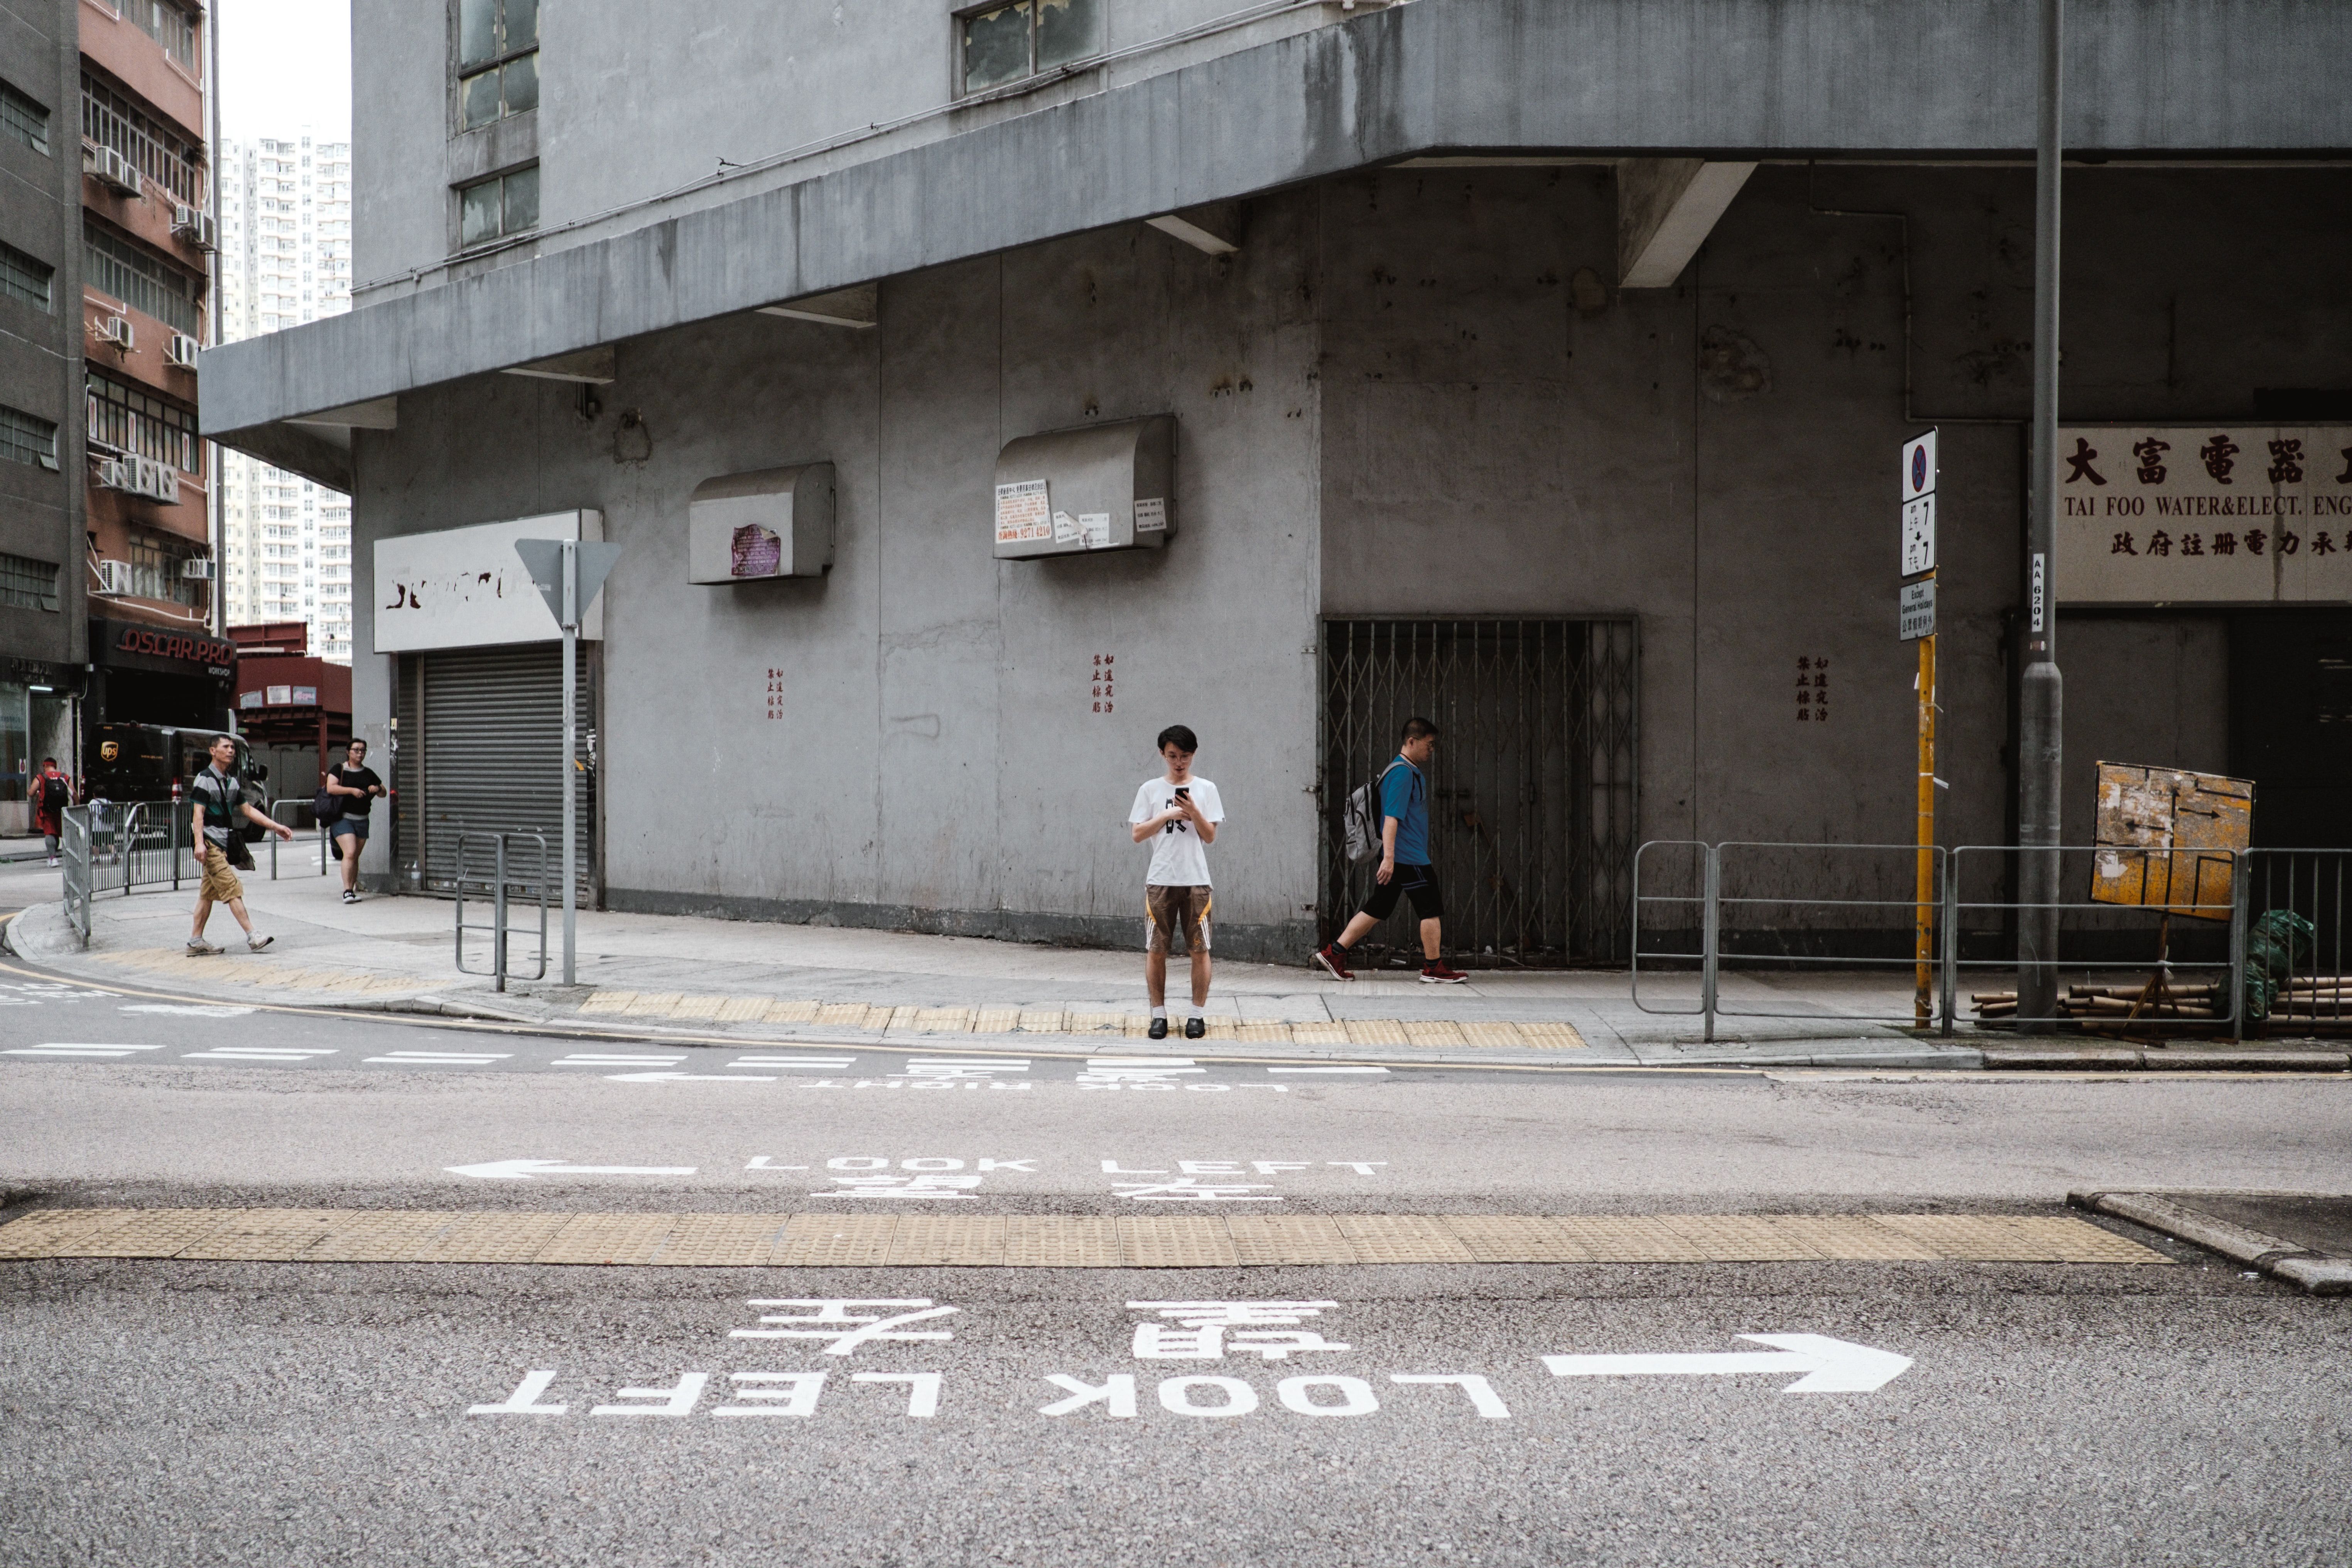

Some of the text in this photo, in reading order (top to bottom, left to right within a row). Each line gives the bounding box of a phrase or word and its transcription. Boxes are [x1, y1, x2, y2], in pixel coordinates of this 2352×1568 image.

[1910, 502, 1929, 525] am 7
[2065, 497, 2094, 516] TAI
[2107, 497, 2144, 516] FOO
[2156, 496, 2302, 516] WATER&ELECT.
[1020, 527, 1034, 538] 9271
[1036, 525, 1050, 537] 4210
[1909, 516, 1918, 531] 上午
[2111, 529, 2352, 556] 政府註册電力承
[1910, 541, 1928, 565] pm 7
[1908, 557, 1918, 570] 下午
[1911, 588, 1924, 599] Except
[1902, 599, 1933, 614] General Holidays
[2033, 586, 2041, 626] 6204
[116, 628, 233, 665] OSCAR PRO
[208, 667, 230, 677] WORKSHOP
[102, 747, 117, 758] ups
[799, 1080, 1288, 1092] LOOK RIGHT
[745, 1156, 1388, 1175] LOOK LEFT
[467, 1369, 1511, 1418] LOOK LEFT
